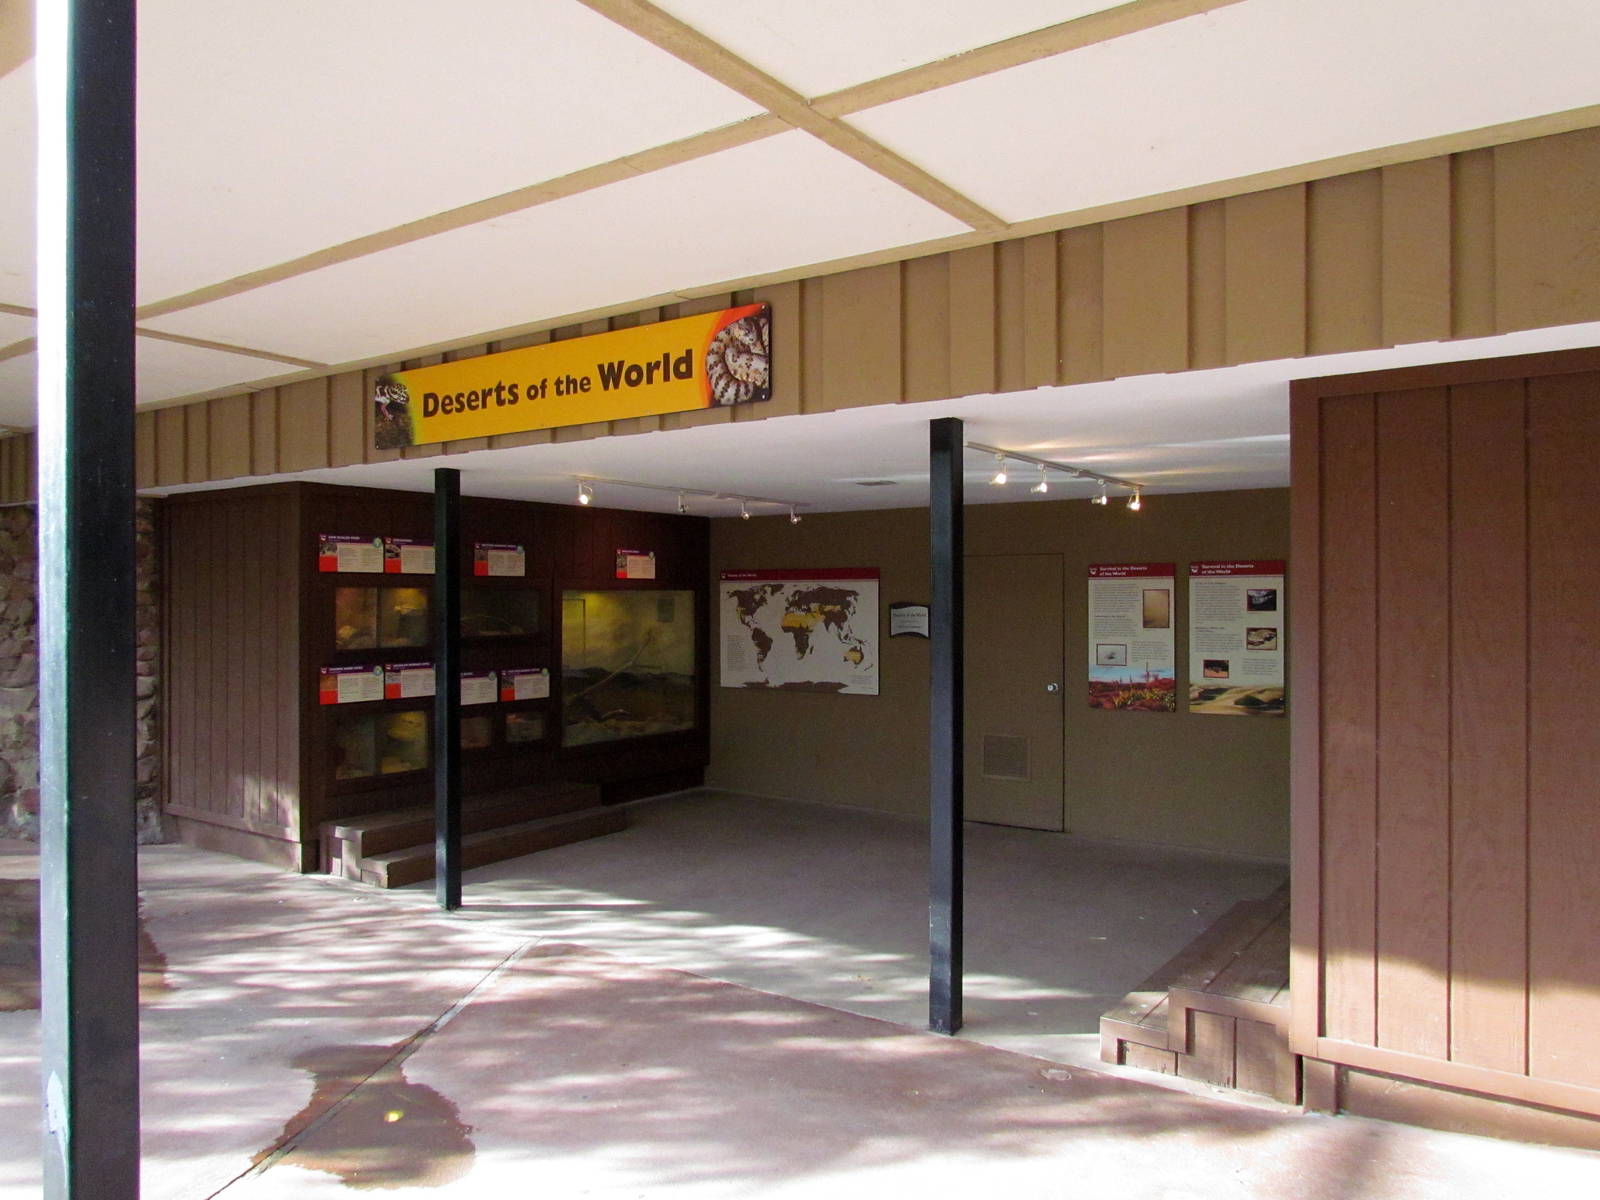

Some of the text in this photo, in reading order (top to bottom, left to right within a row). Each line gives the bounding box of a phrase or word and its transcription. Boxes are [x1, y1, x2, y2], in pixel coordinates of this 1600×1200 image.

[423, 350, 693, 418] Deserts of the World
